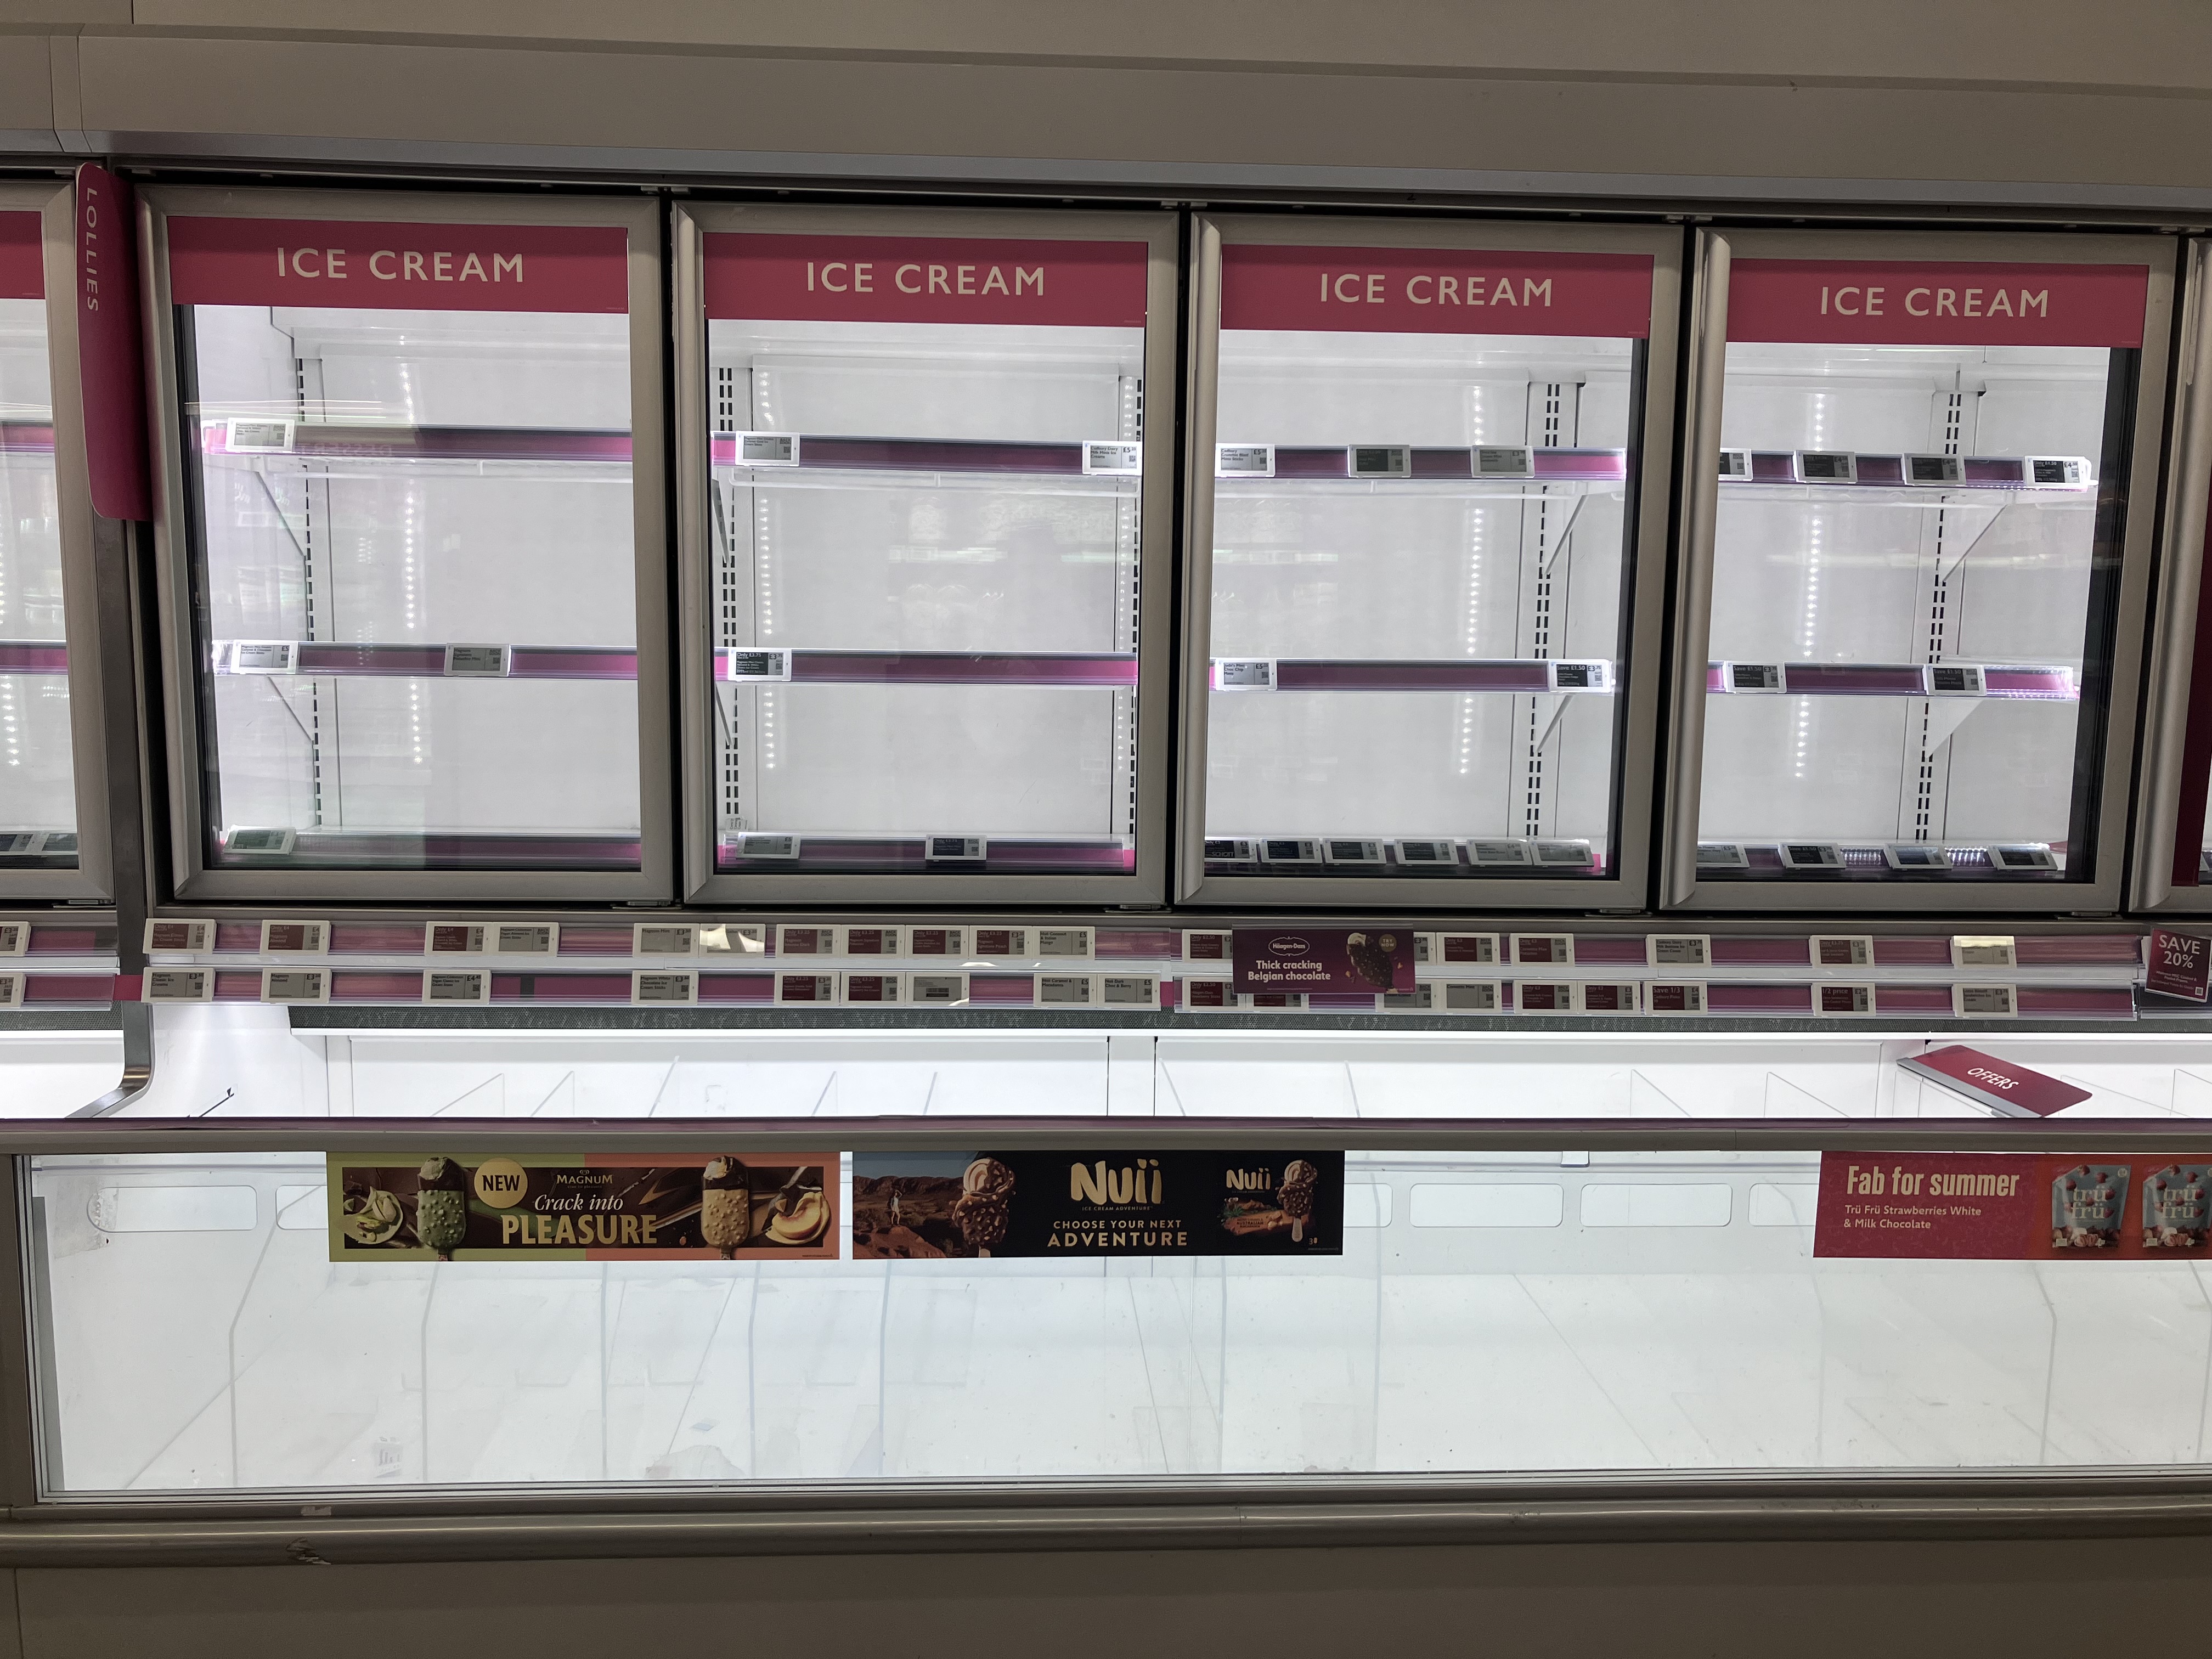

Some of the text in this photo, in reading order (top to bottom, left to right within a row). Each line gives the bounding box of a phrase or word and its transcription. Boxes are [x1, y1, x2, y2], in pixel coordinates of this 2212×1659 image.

[87, 188, 99, 312] LOLLIES
[278, 247, 523, 283] ICE CREAM
[808, 262, 1044, 296] ICE CREAM
[1321, 273, 1552, 307] ICE CREAM
[1821, 286, 2048, 318] ICE CREAM
[2159, 934, 2201, 955] SAVE
[1256, 960, 1323, 972] Thick cracking
[2163, 950, 2193, 969] 20%
[1248, 971, 1331, 983] Belgian chocolate
[1967, 1067, 2020, 1090] OFFERS
[482, 1174, 520, 1192] NEW
[556, 1175, 614, 1184] MAGNUM
[1070, 1158, 1163, 1205] Nuii
[1226, 1167, 1271, 1190] Nuii
[1847, 1165, 2020, 1197] Fab for summer
[535, 1194, 624, 1211] Crack into
[2073, 1185, 2107, 1202] trü
[2163, 1185, 2197, 1202] trü
[1845, 1204, 1982, 1216] Trü Frü Strawberries White
[2070, 1201, 2106, 1219] frü
[2161, 1201, 2196, 1219] frü
[500, 1214, 657, 1245] PLEASURE
[1053, 1220, 1182, 1229] CHOOSE YOUR NEXT
[1843, 1218, 1931, 1229] & Milk Chocolate
[1047, 1231, 1187, 1248] ADVENTURE
